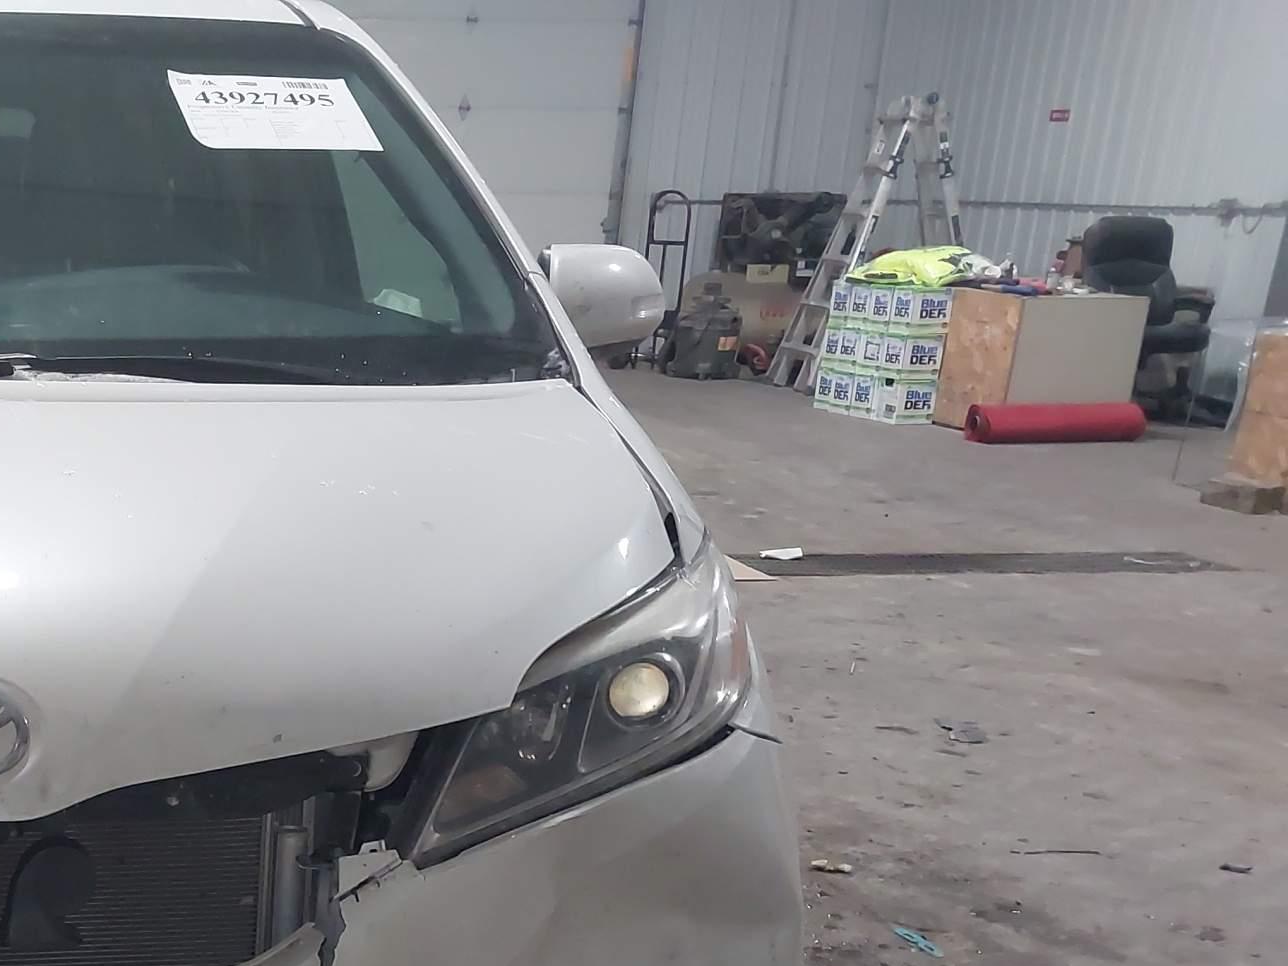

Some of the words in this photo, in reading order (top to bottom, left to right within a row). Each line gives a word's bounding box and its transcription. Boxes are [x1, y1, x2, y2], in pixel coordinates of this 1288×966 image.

[194, 91, 335, 107] 43927495
[921, 298, 948, 309] Blue
[920, 308, 947, 319] DEF
[912, 344, 938, 355] Blue
[910, 354, 937, 365] DEF
[906, 389, 933, 400] Blue
[904, 399, 931, 410] DEF
